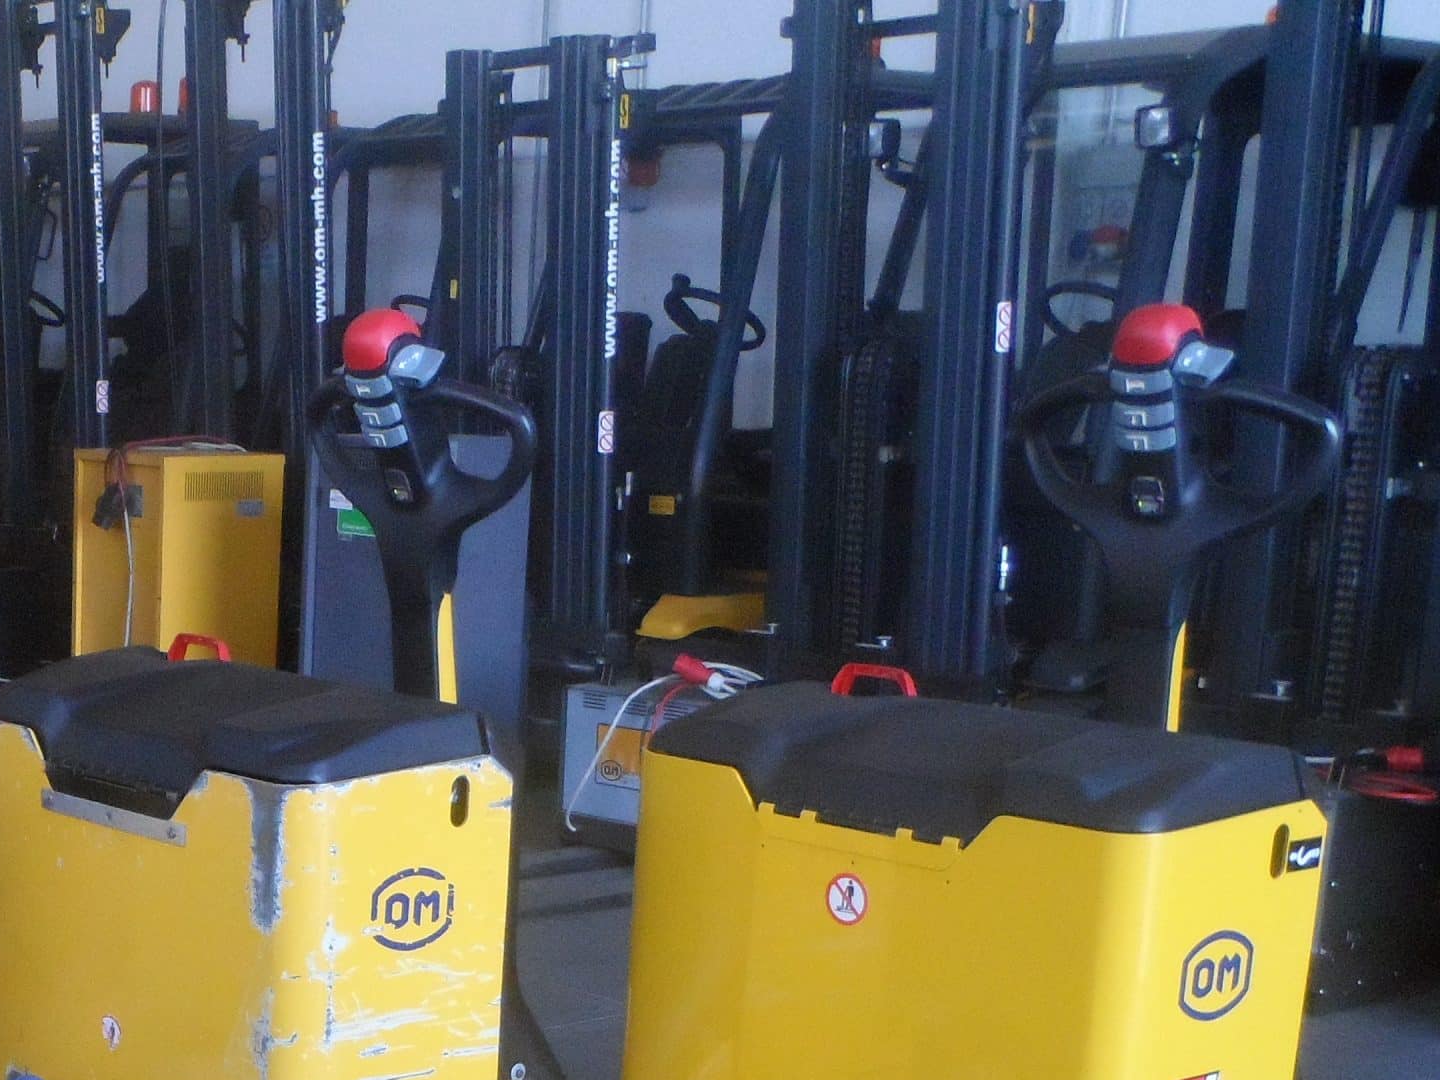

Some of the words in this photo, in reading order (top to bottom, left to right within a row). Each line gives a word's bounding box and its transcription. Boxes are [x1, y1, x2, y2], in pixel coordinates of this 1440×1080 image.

[90, 114, 104, 283] www.om-mh.com
[311, 131, 326, 323] www.om-mh.com
[604, 139, 620, 358] www.om-mh.com
[385, 890, 440, 928] OM
[1192, 953, 1242, 998] OM
